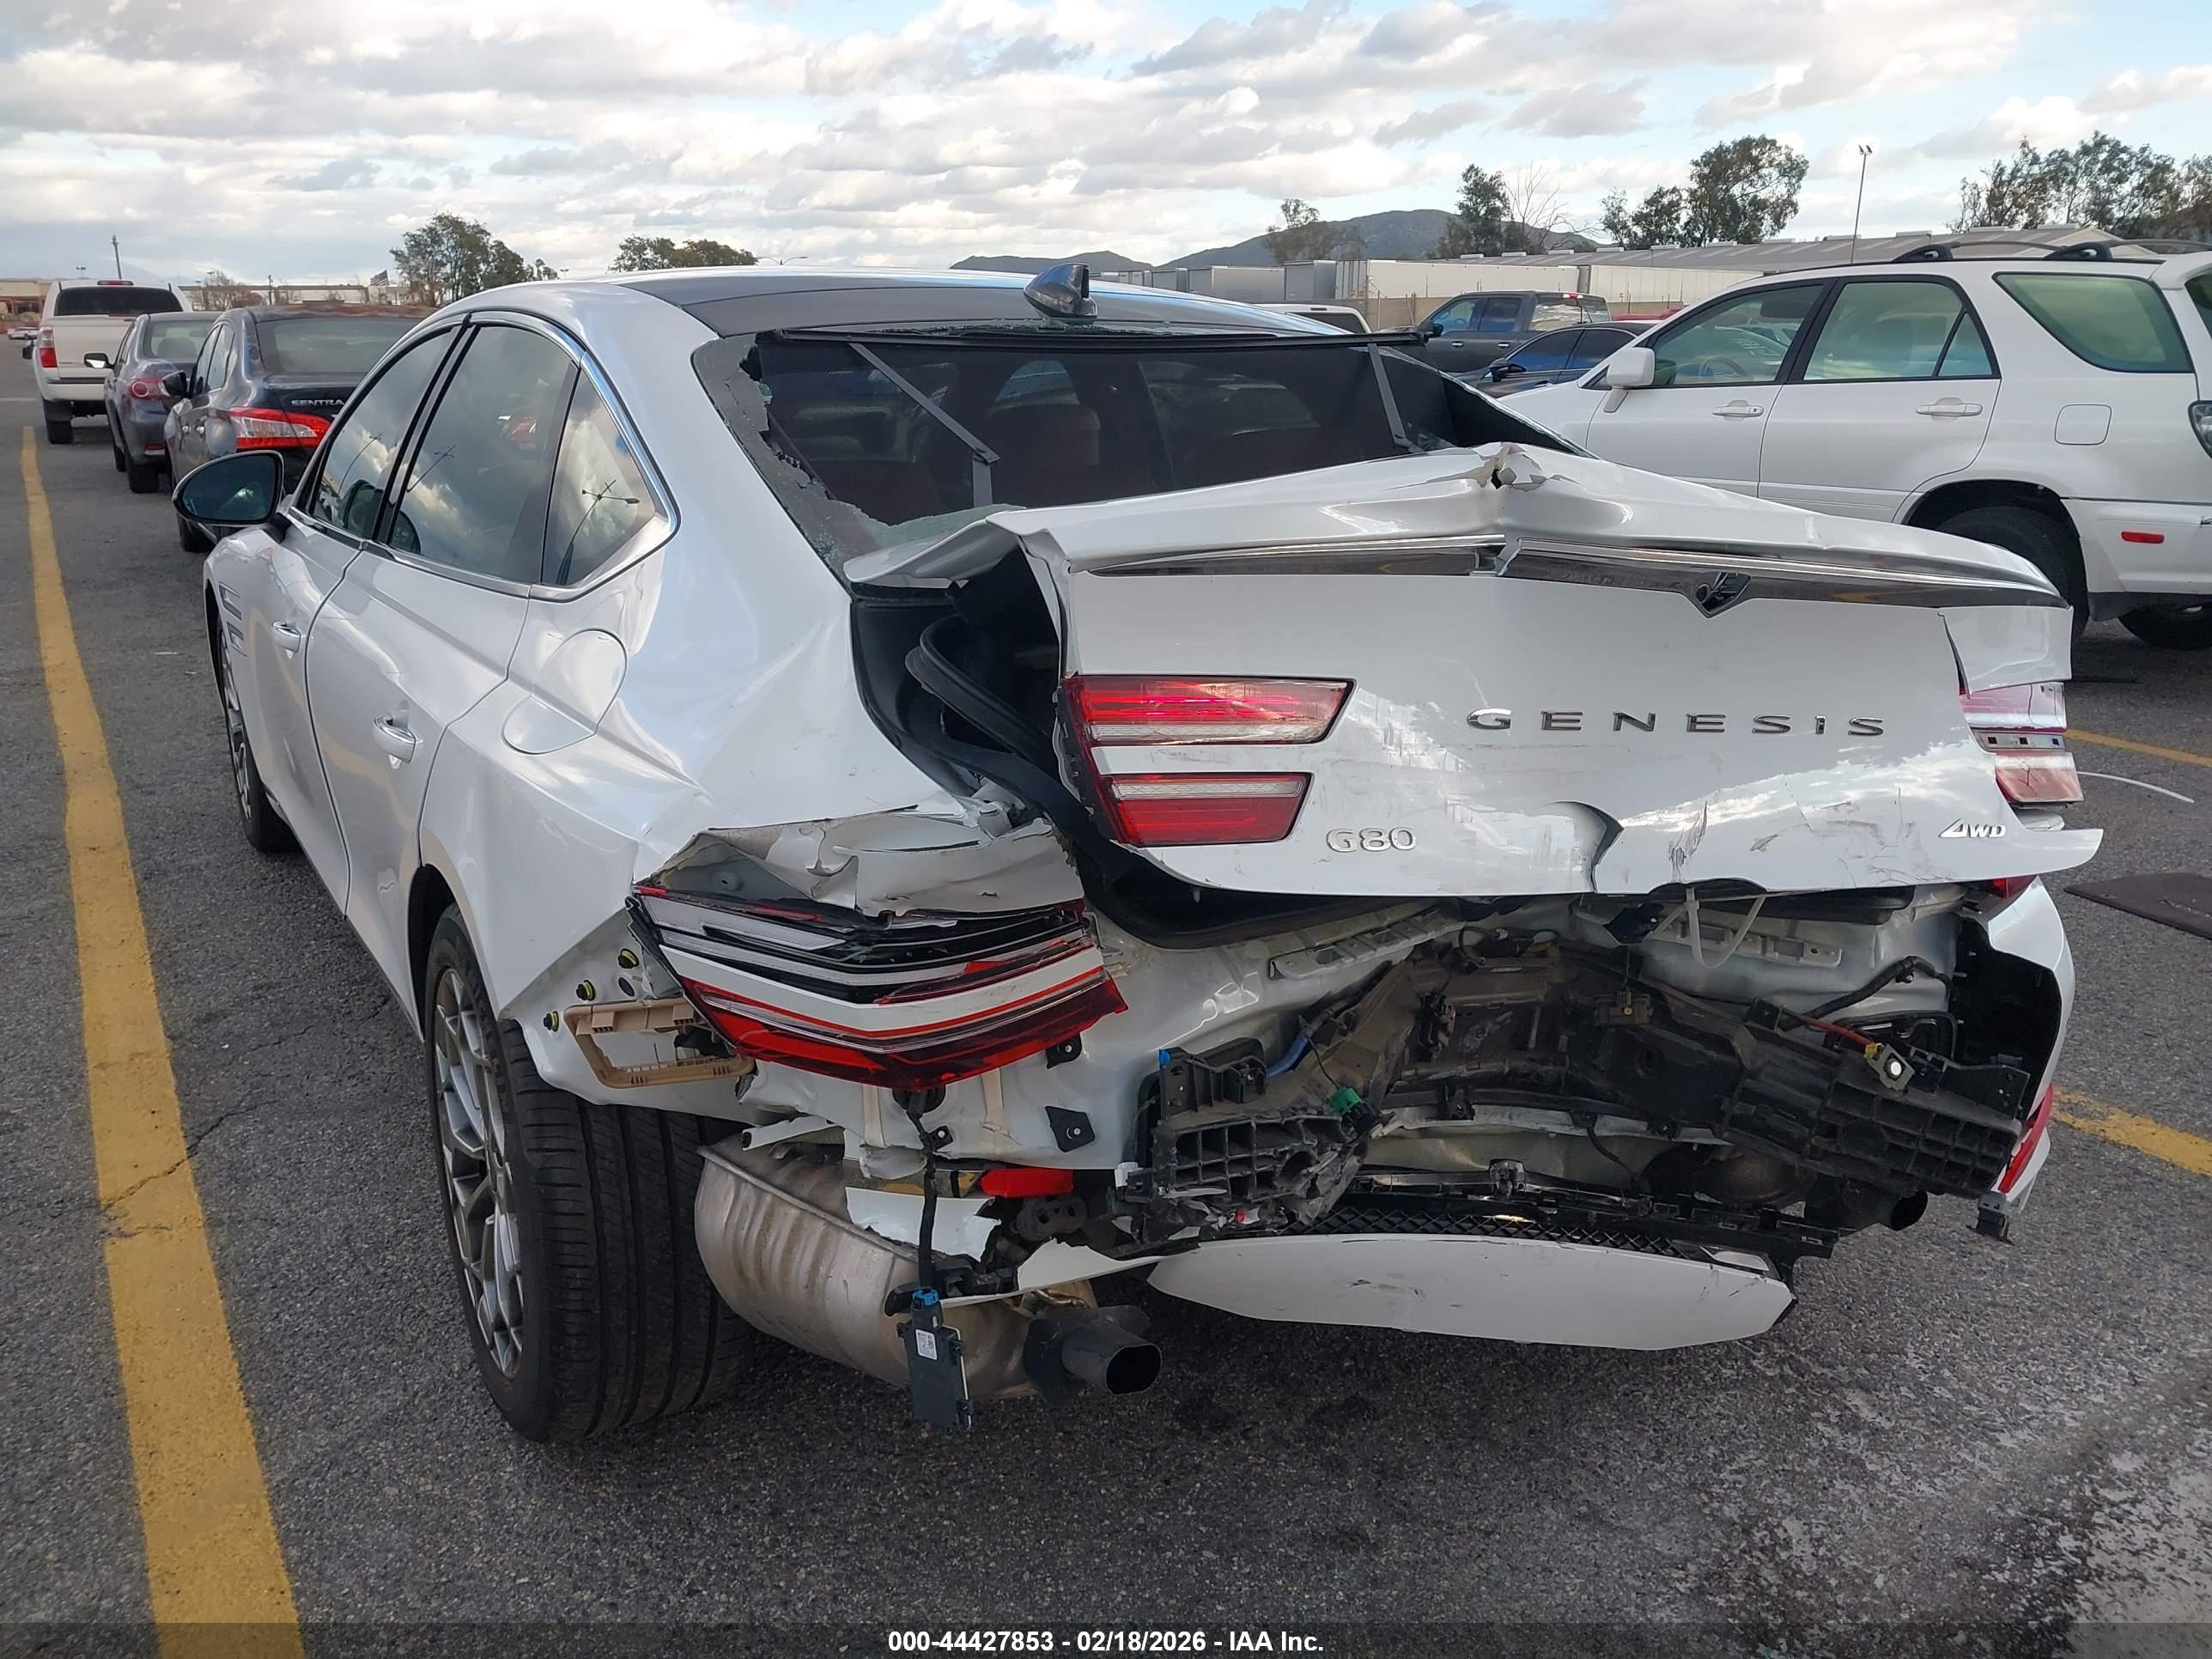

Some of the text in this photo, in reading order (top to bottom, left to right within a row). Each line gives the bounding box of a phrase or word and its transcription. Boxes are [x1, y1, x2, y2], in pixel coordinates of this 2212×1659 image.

[1466, 708, 1885, 737] GENESIS
[1326, 827, 1417, 853] G80
[1938, 817, 2007, 838] AWD
